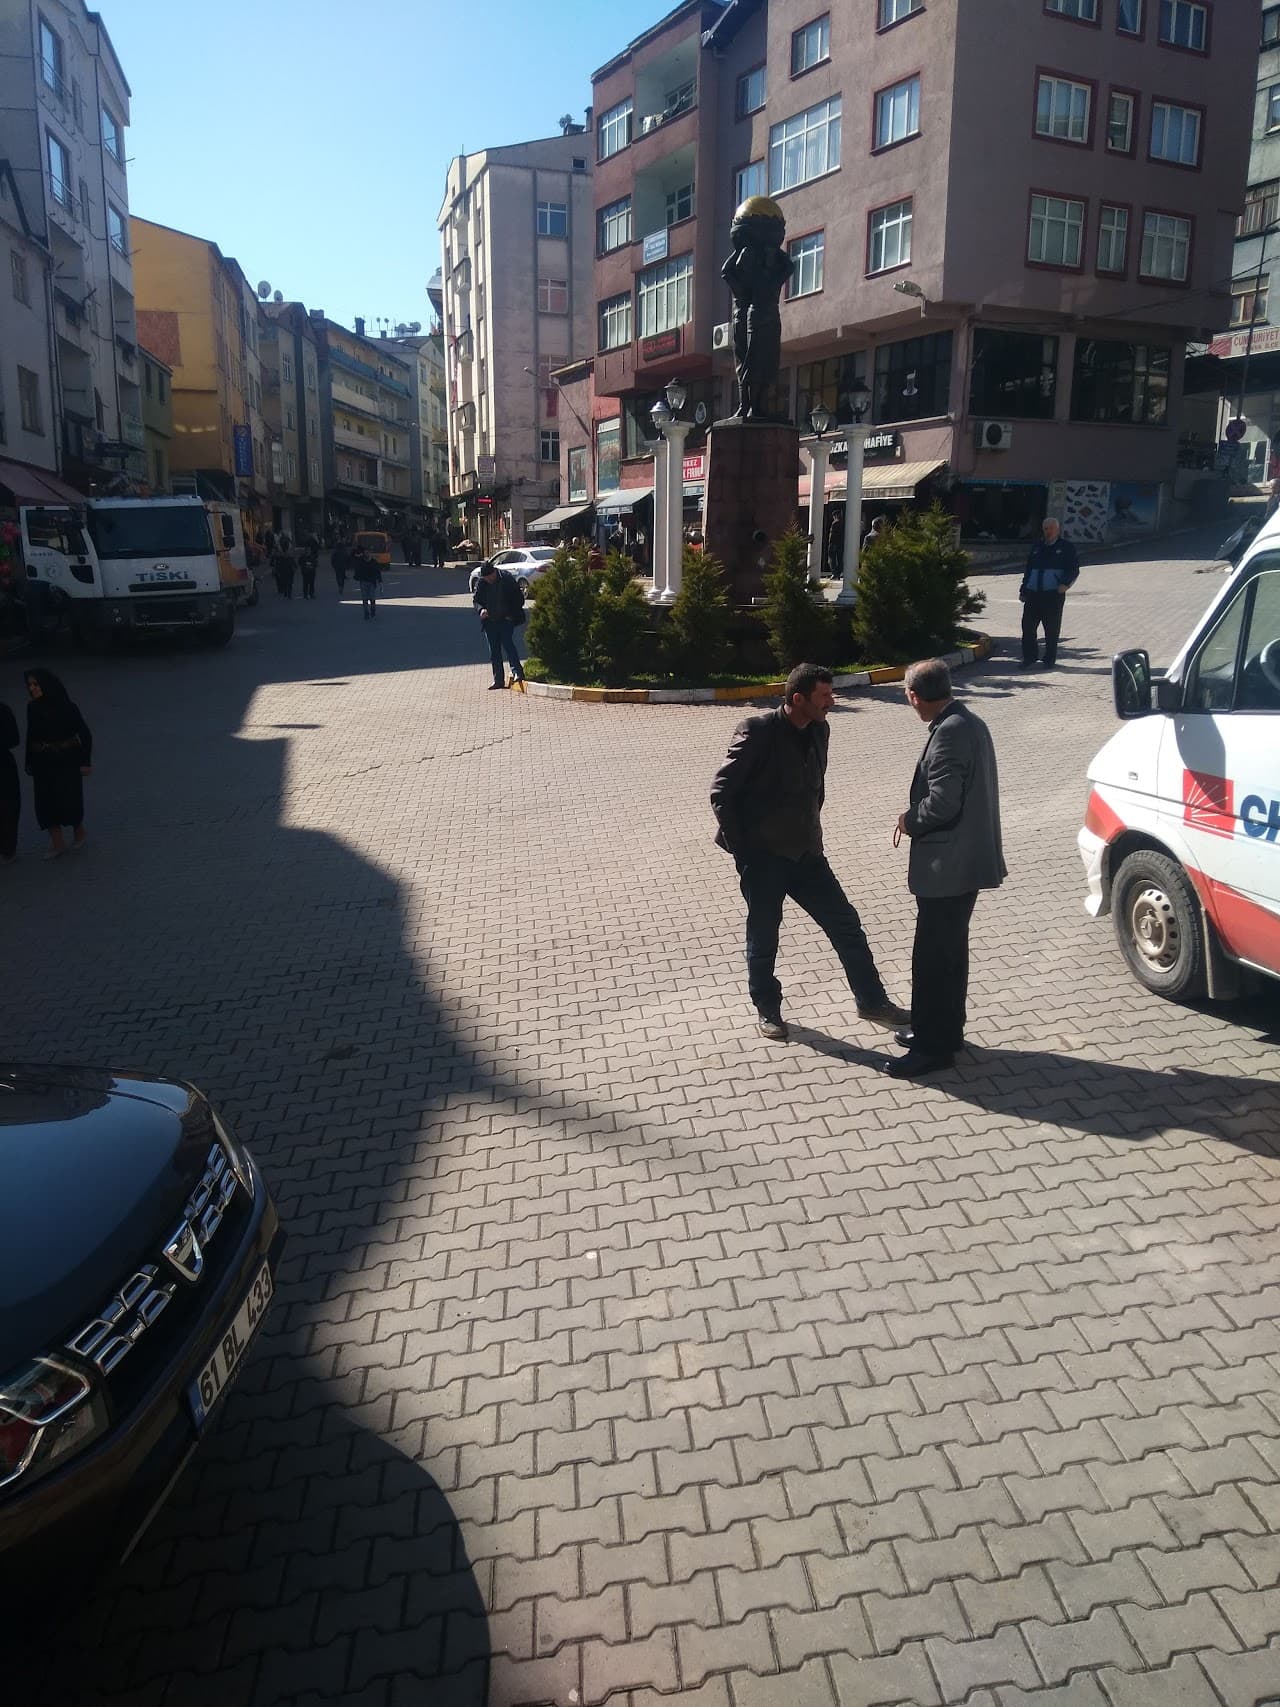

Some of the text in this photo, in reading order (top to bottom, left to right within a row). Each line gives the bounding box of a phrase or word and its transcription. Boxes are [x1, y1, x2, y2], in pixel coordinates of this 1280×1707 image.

[200, 1266, 271, 1407] 61 BL 433
